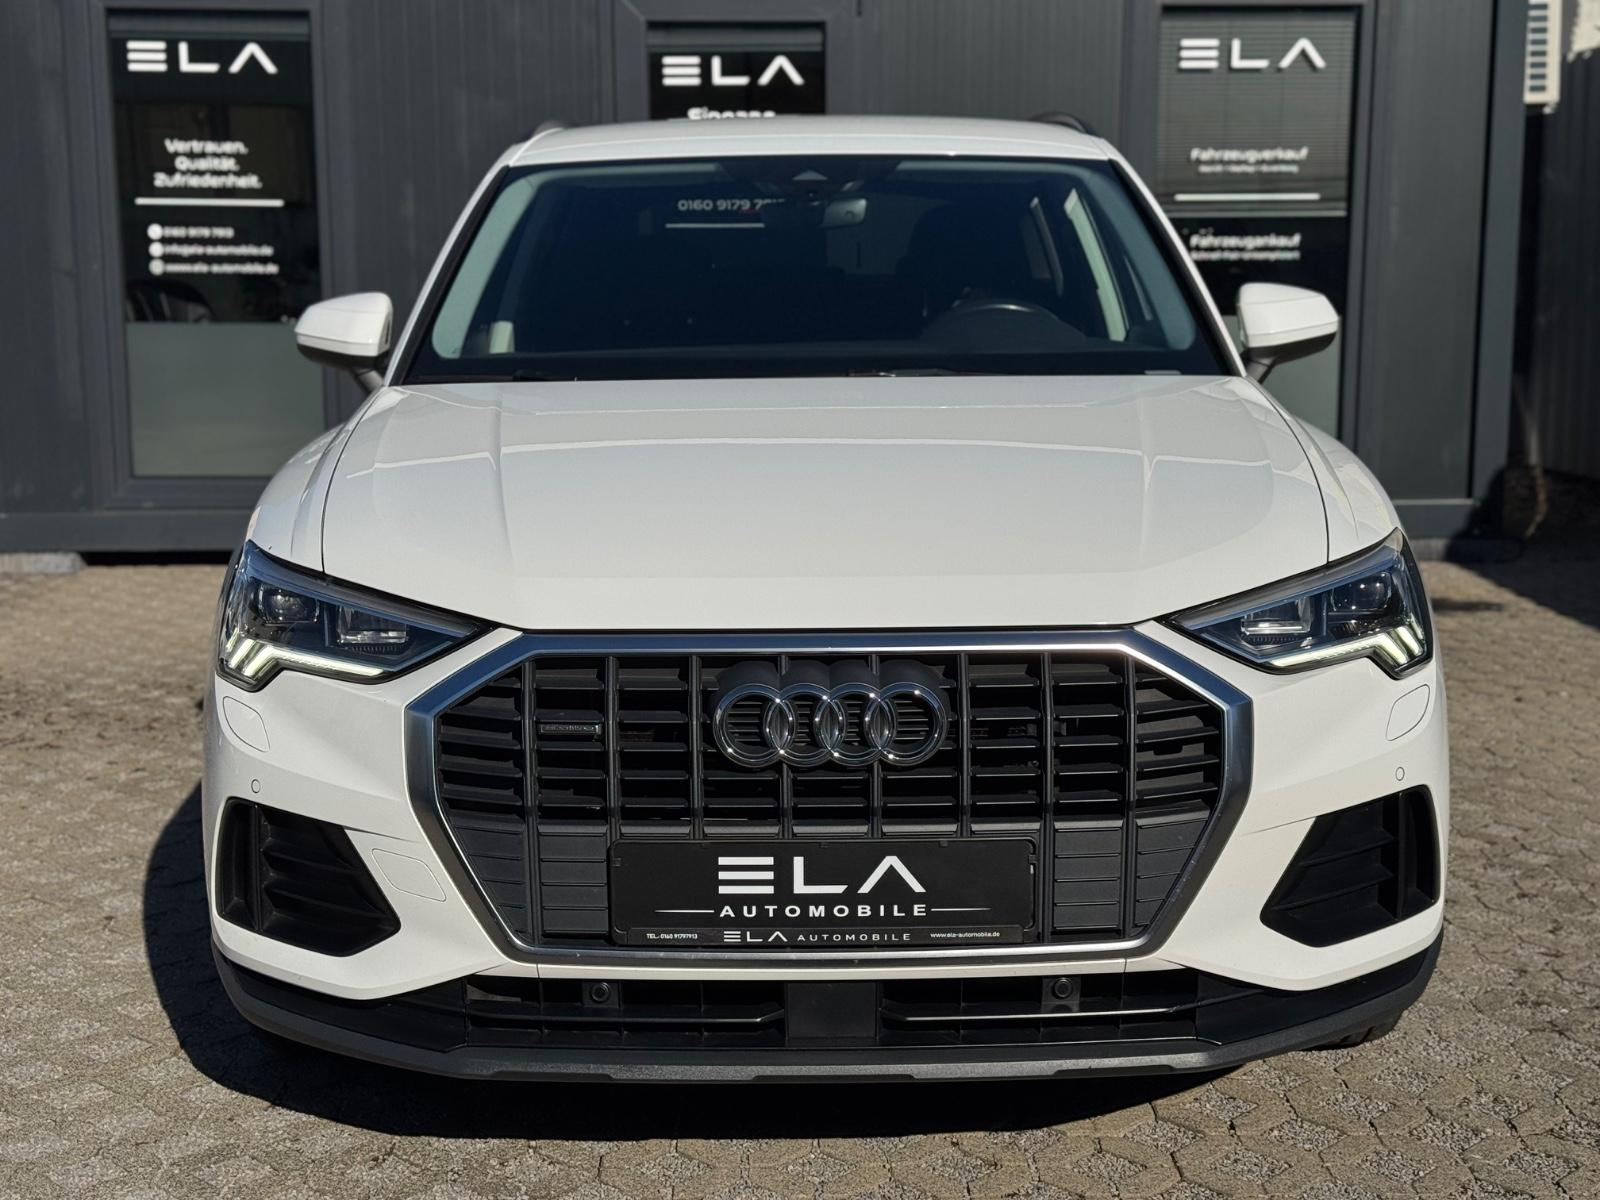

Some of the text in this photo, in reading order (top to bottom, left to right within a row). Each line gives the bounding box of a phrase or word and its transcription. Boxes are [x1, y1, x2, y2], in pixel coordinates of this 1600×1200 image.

[126, 40, 278, 74] ELA
[1179, 37, 1326, 69] ELA
[661, 55, 804, 86] ELA
[678, 199, 713, 211] 0160
[717, 199, 750, 211] 9179
[718, 855, 927, 894] ELA
[719, 904, 927, 918] AUTOMOBILE
[723, 930, 911, 942] ELA AUTOMOBILE
